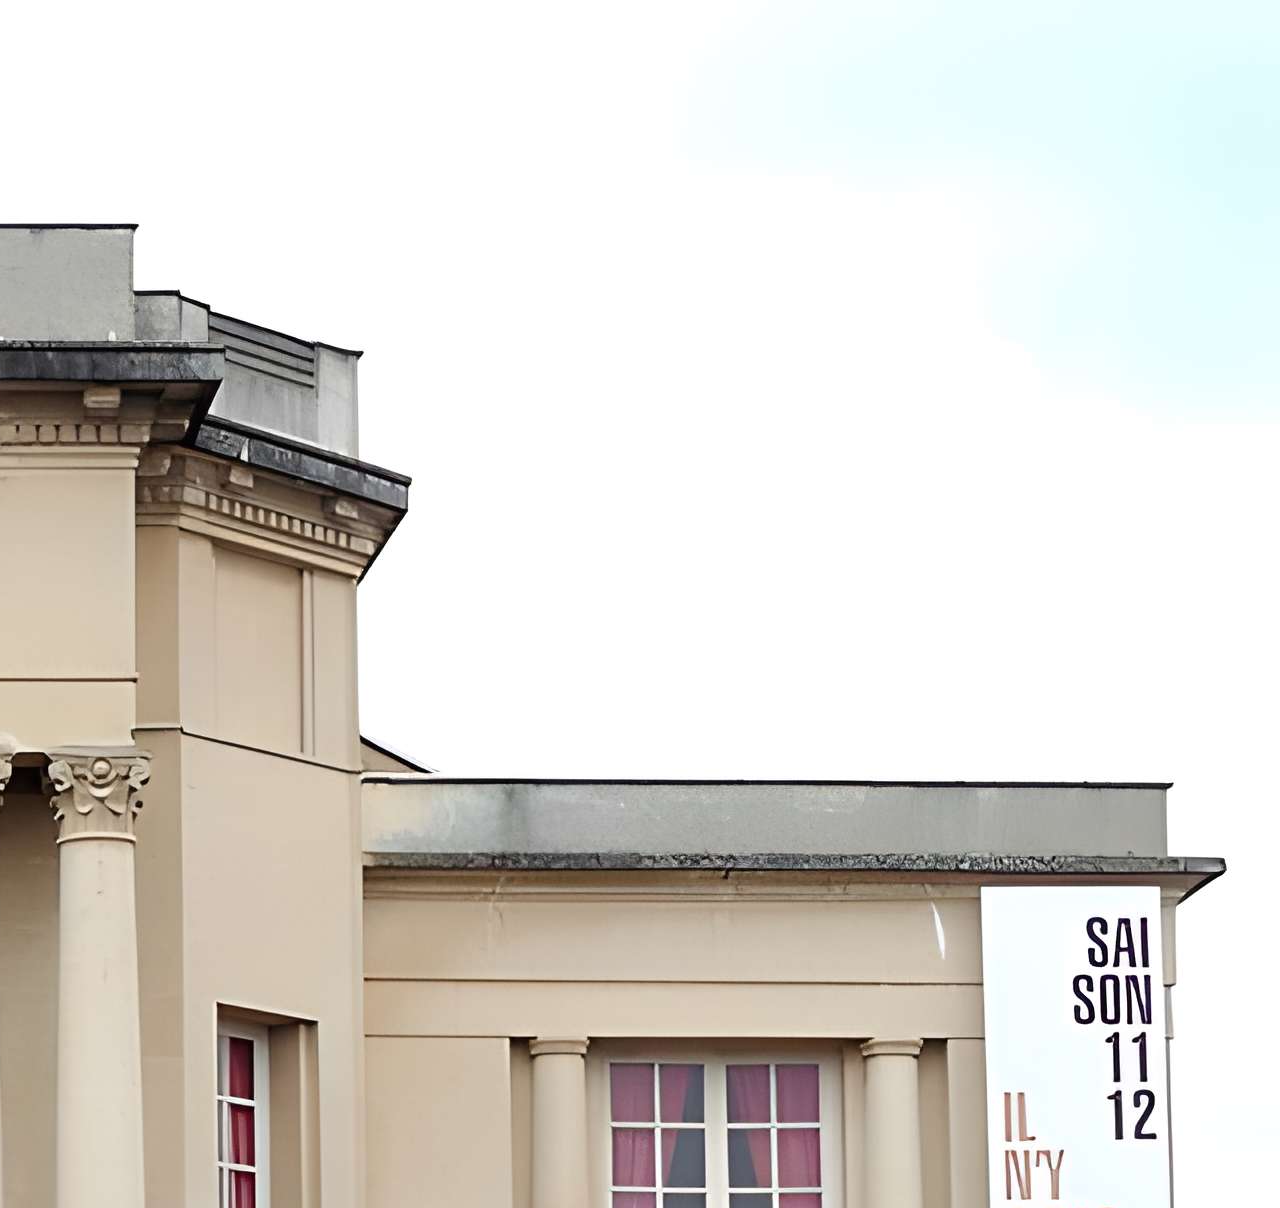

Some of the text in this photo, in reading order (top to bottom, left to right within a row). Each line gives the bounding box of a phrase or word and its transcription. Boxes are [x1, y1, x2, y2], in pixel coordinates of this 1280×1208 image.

[1086, 917, 1149, 968] SAI
[1073, 974, 1152, 1025] SON
[1105, 1032, 1148, 1083] 11
[1004, 1092, 1036, 1142] IL
[1107, 1089, 1157, 1140] 12
[1005, 1150, 1064, 1200] N'Y
